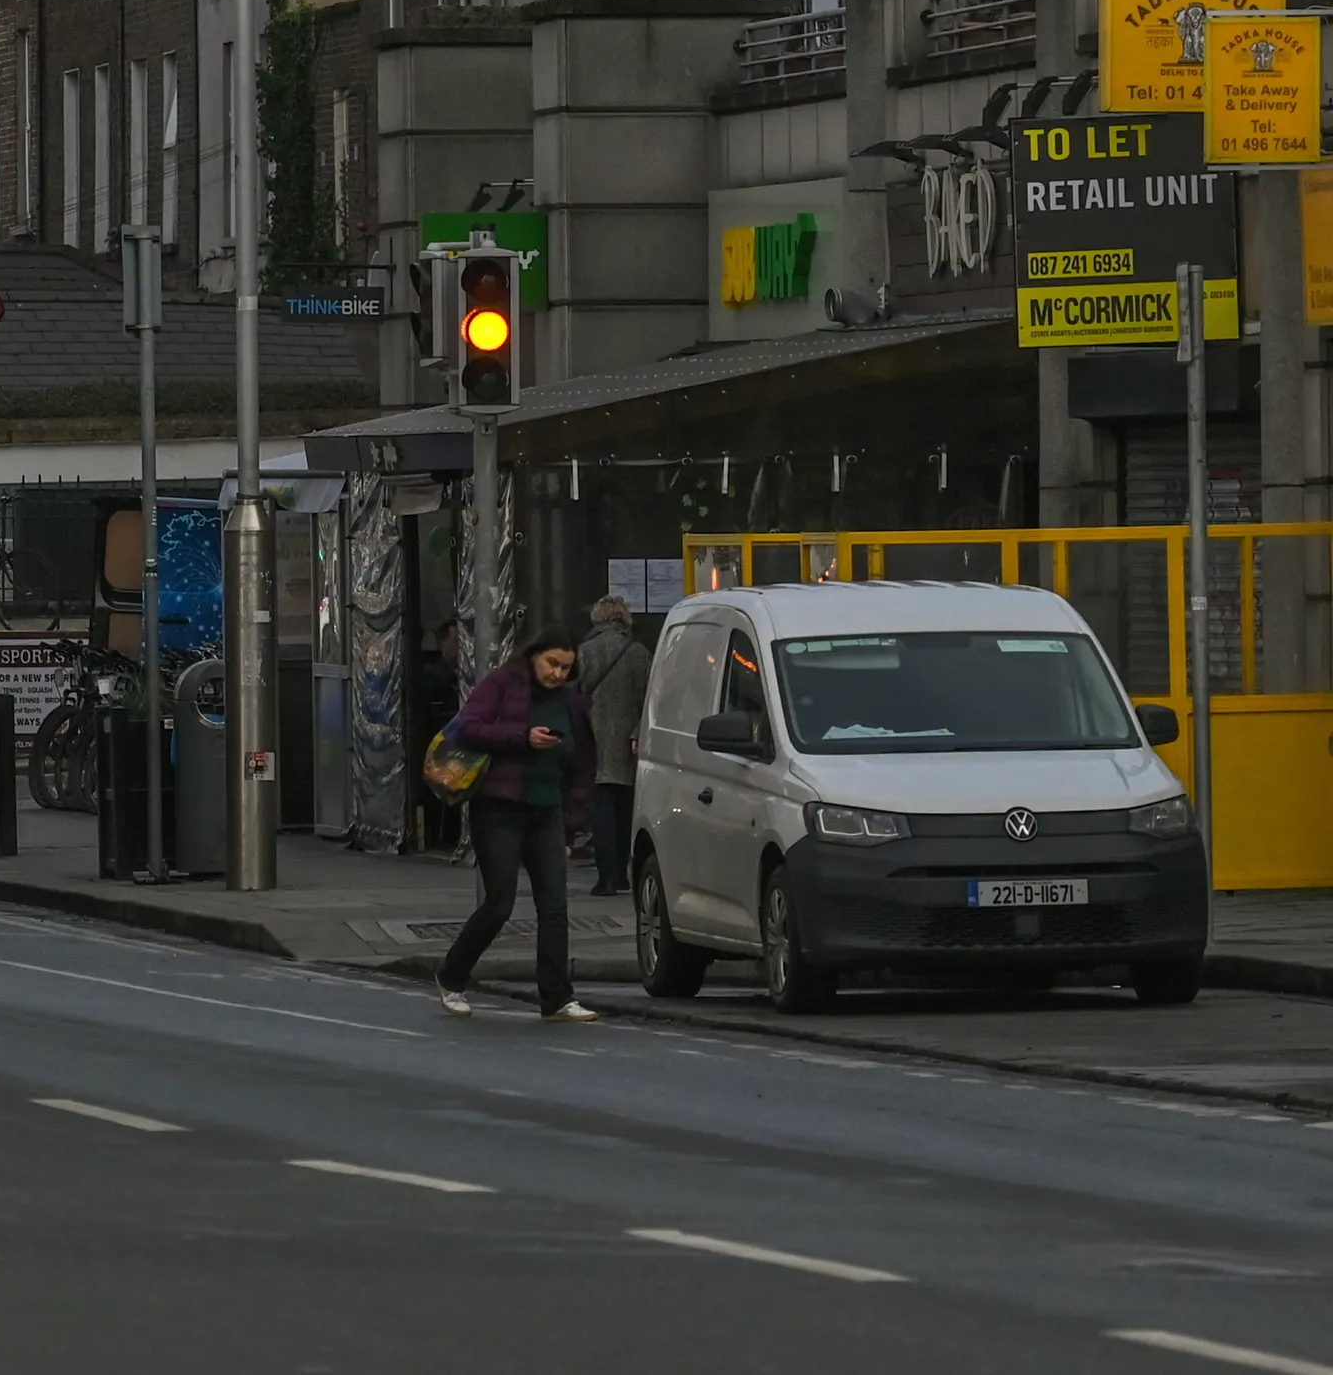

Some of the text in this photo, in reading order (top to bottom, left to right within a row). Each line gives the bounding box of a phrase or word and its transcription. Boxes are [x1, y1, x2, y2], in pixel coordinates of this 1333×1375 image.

[1221, 28, 1306, 55] TADKA HOUSE
[1126, 85, 1159, 100] Tel:
[1165, 86, 1184, 100] 01
[1223, 84, 1299, 98] Take Away
[1225, 99, 1297, 113] & Delivery
[1250, 120, 1276, 133] Tel:
[1023, 124, 1152, 161] TO LET
[1221, 138, 1307, 151] 01 496 7644
[1026, 174, 1218, 212] RETAIL UNIT
[920, 159, 997, 278] BAKED
[721, 213, 817, 306] SUBWAY
[1029, 253, 1131, 276] 087 241 6934
[1030, 293, 1172, 327] McCORMICK
[1, 648, 65, 664] SPORTS
[13, 673, 20, 683] A
[21, 673, 42, 683] NEW
[14, 718, 41, 726] WAYS
[992, 885, 1074, 904] 221-D-11671
